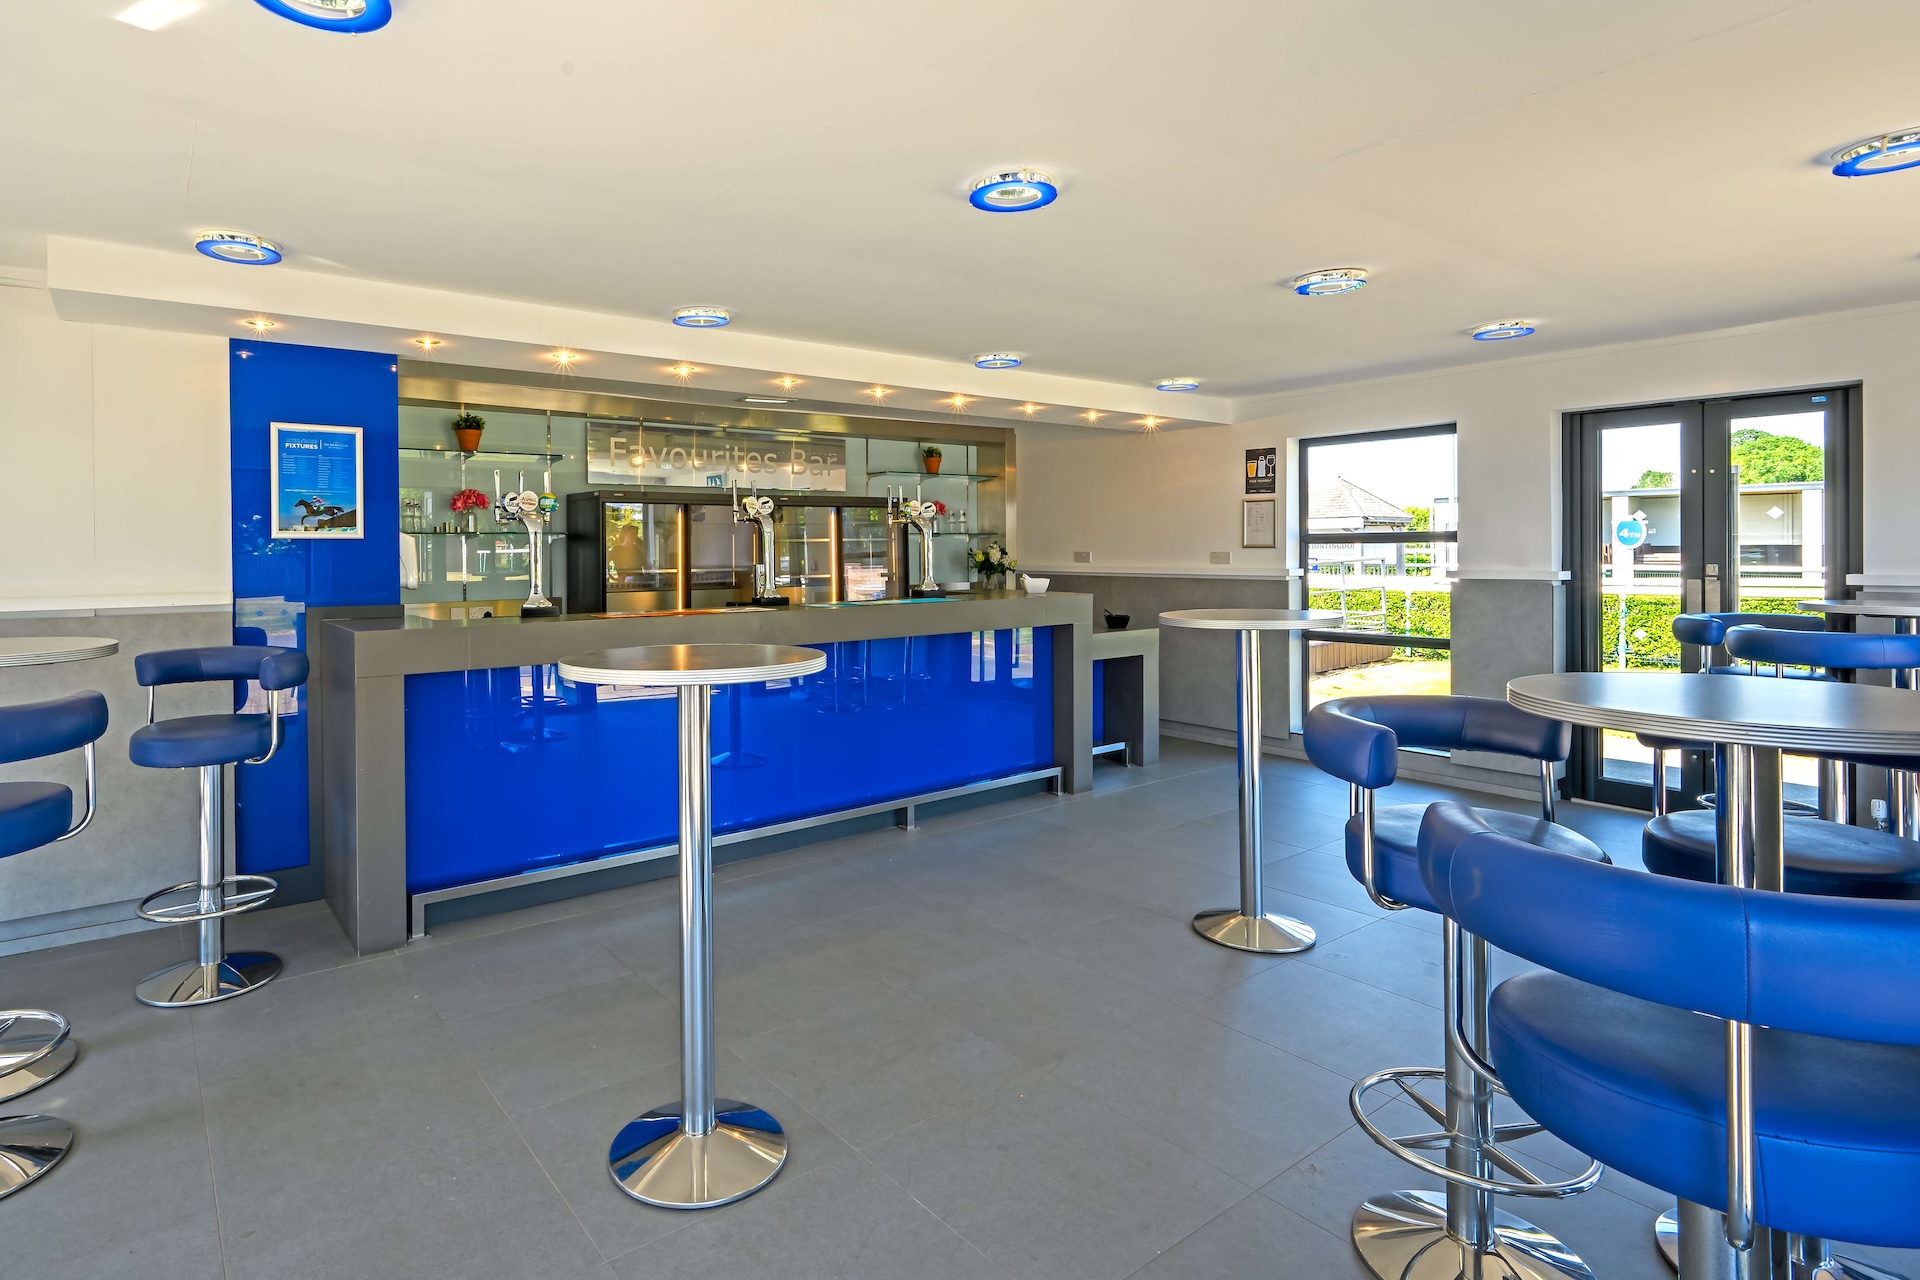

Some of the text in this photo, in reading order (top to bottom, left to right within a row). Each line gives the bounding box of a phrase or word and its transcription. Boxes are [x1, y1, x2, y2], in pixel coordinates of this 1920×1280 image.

[285, 442, 319, 450] FIXTURES
[609, 436, 837, 477] Favourites Bar
[1618, 527, 1642, 539] 4TH
